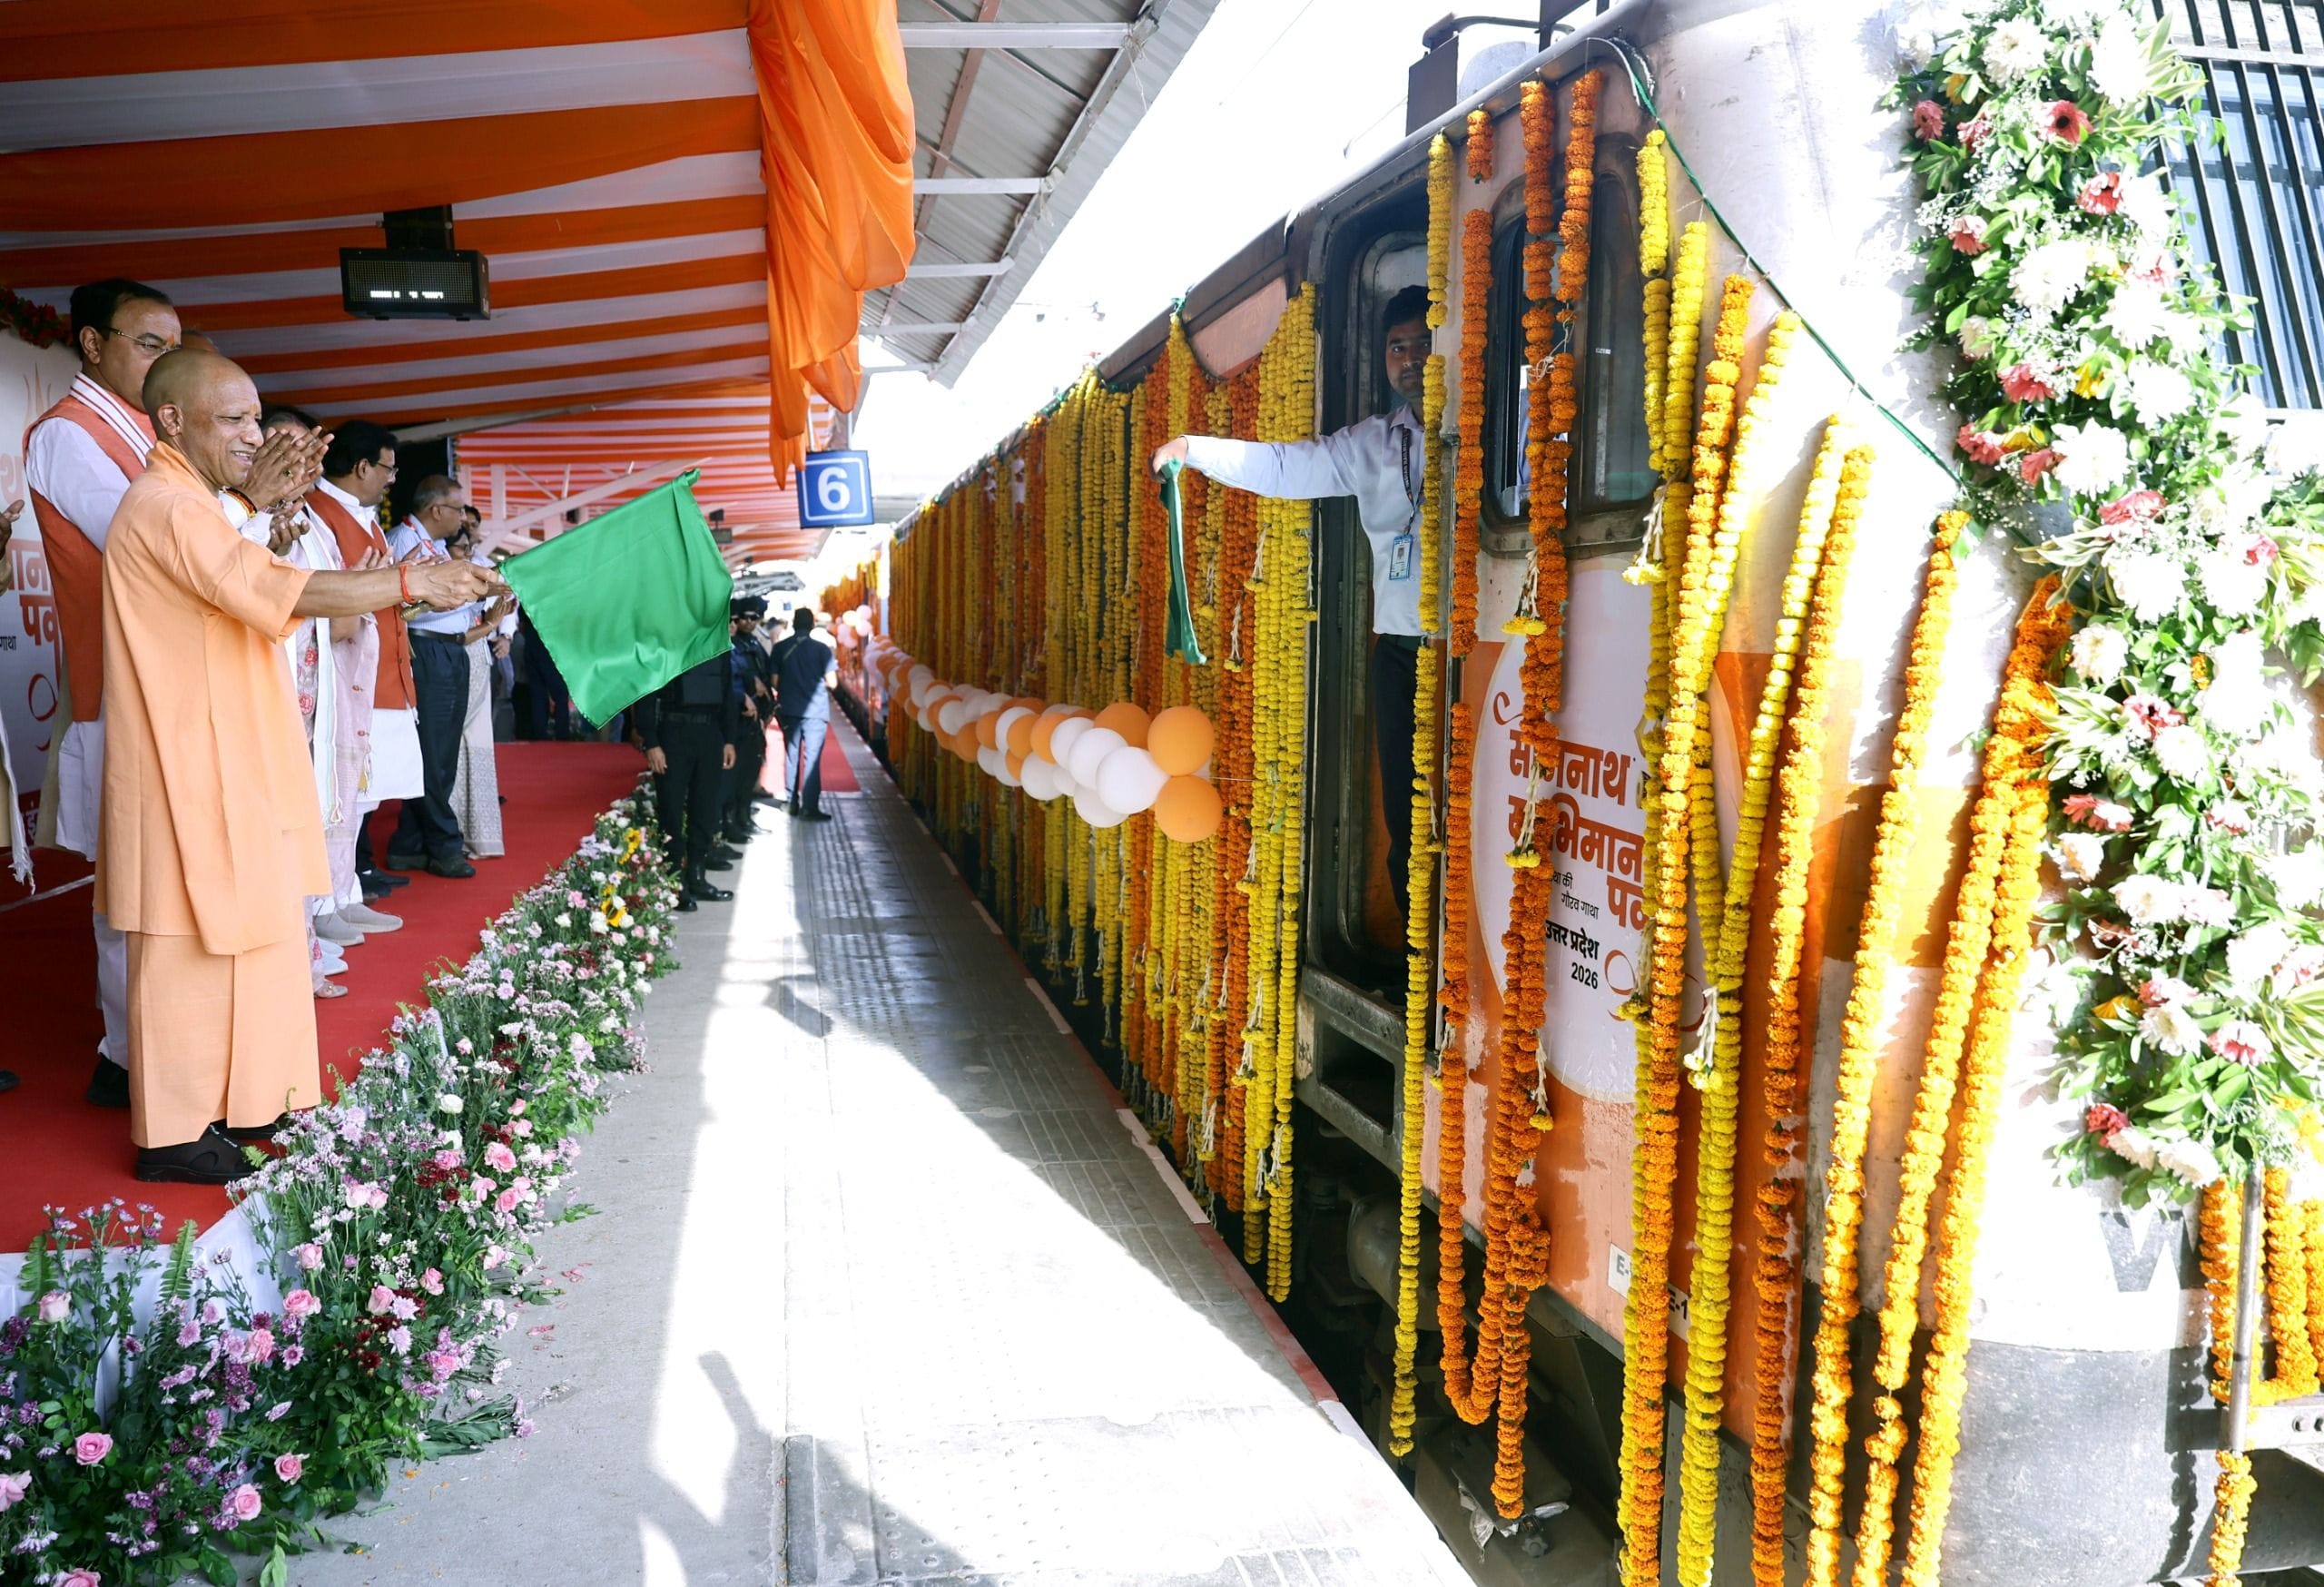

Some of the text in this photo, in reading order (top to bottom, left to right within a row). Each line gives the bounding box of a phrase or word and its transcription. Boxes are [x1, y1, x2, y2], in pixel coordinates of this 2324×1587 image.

[817, 466, 851, 511] 6
[1545, 919, 1600, 961] उत्तर प्रदेश
[1571, 961, 1598, 990] 2026
